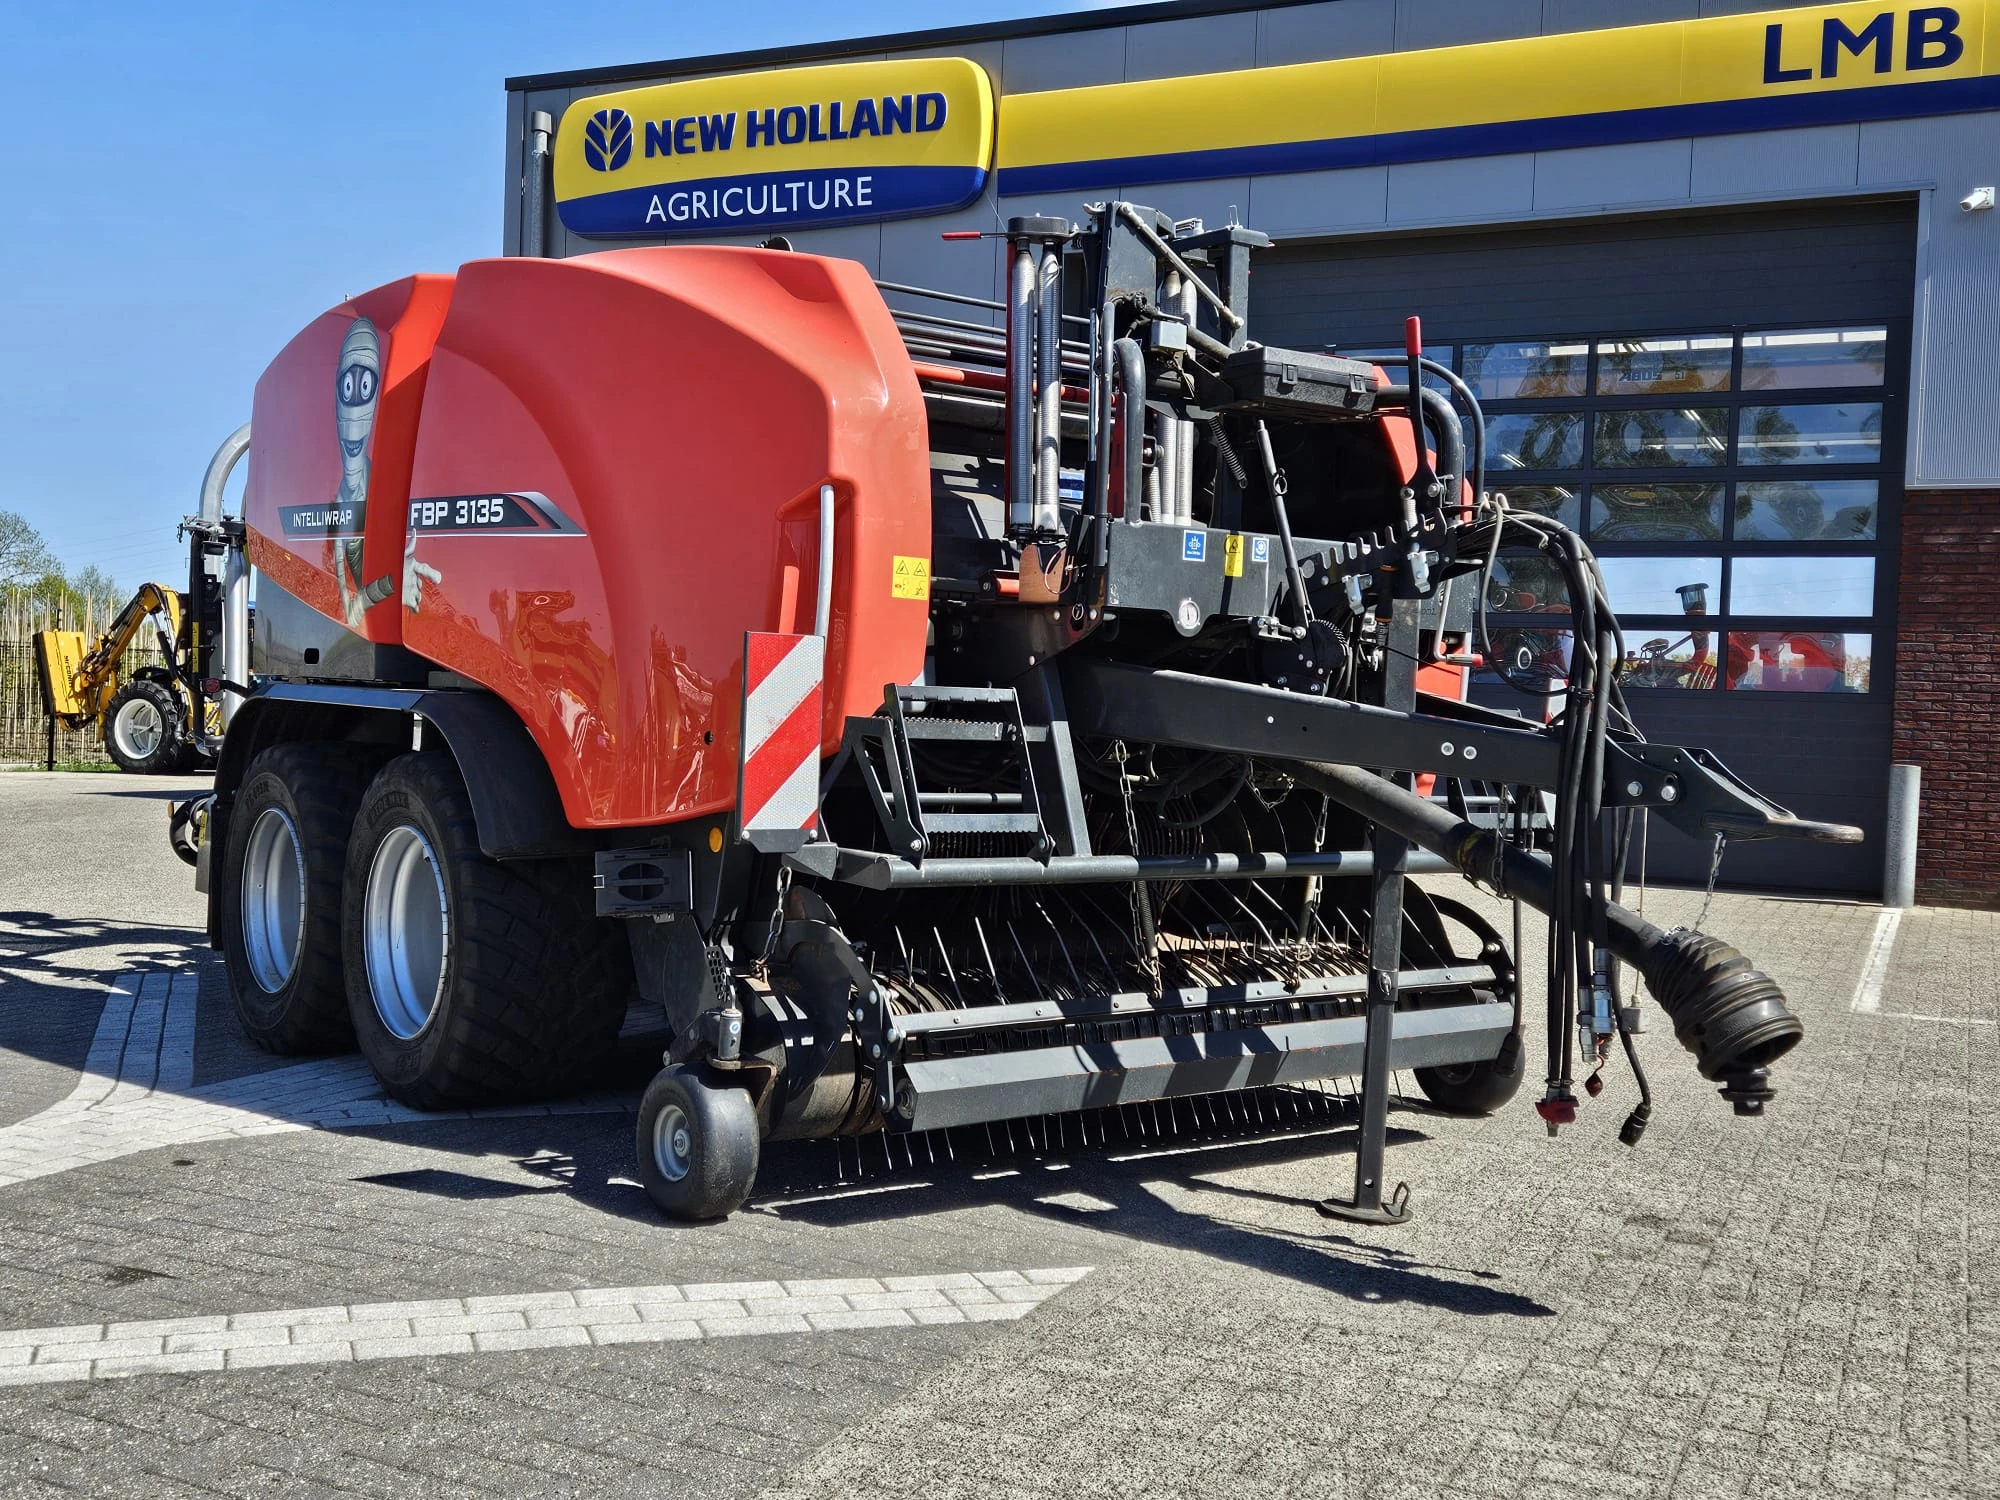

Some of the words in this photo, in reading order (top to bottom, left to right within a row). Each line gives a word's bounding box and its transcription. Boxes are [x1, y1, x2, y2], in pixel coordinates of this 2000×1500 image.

[1763, 6, 1964, 84] LMB
[645, 112, 736, 158] NEW
[746, 92, 947, 147] HOLLAND
[645, 175, 873, 223] AGRICULTURE
[293, 509, 352, 528] INTELLIWRAP
[410, 501, 449, 526] FBP
[455, 498, 504, 524] 3135
